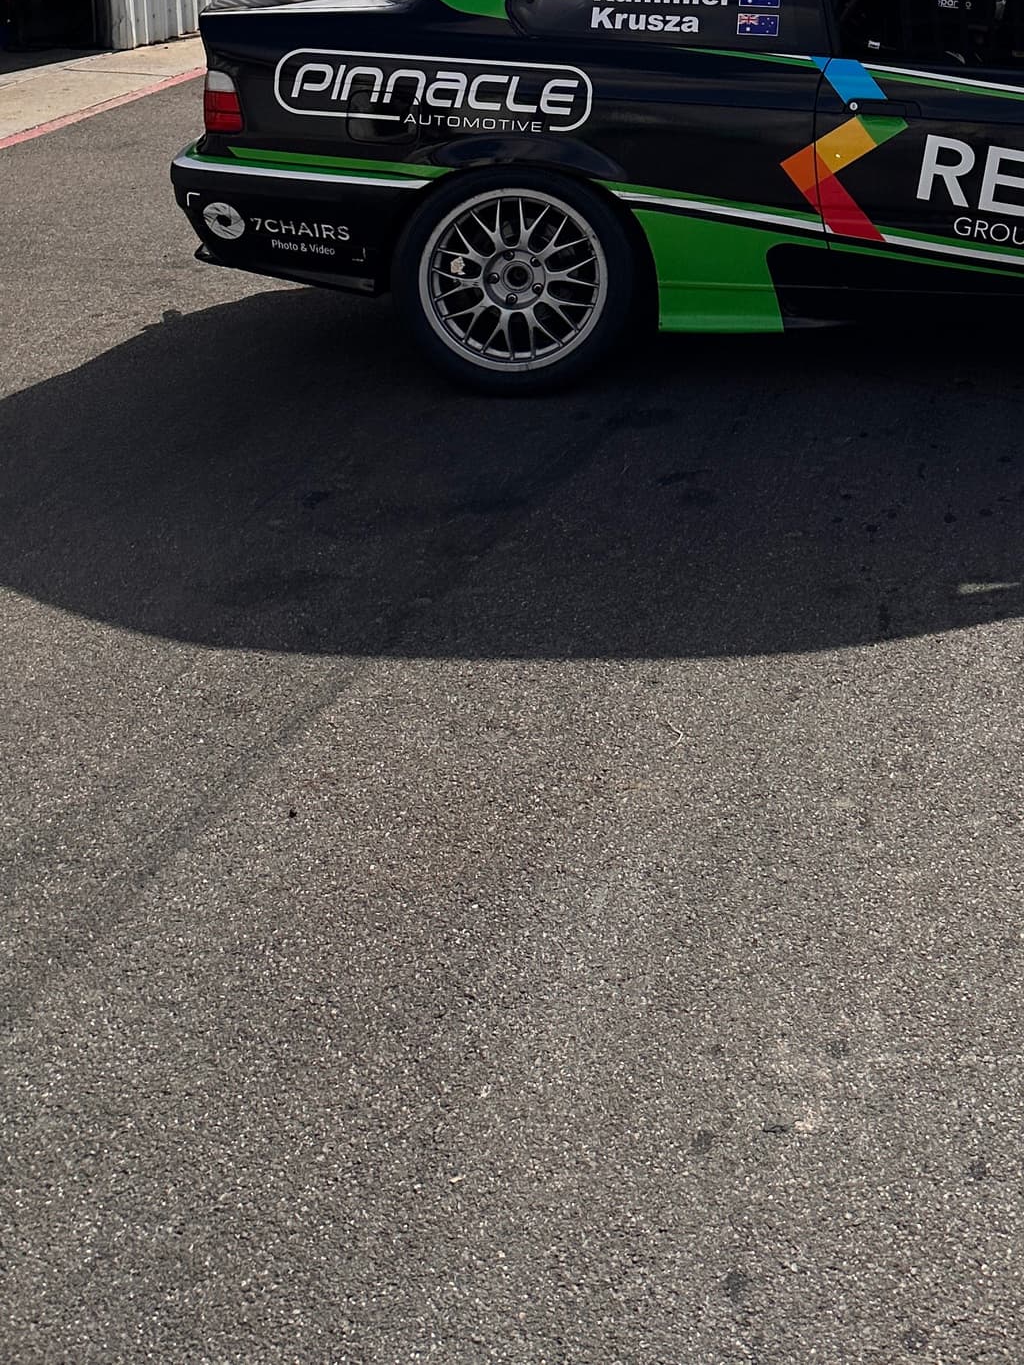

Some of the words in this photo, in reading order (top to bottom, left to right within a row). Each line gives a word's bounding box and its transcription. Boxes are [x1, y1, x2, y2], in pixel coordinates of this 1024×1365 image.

[590, 7, 700, 33] Krusza
[403, 113, 542, 133] AUTOMOTIVE
[250, 217, 351, 241] 7CHAIRS
[271, 239, 299, 252] Photo
[300, 242, 308, 253] &
[309, 243, 336, 256] Video
